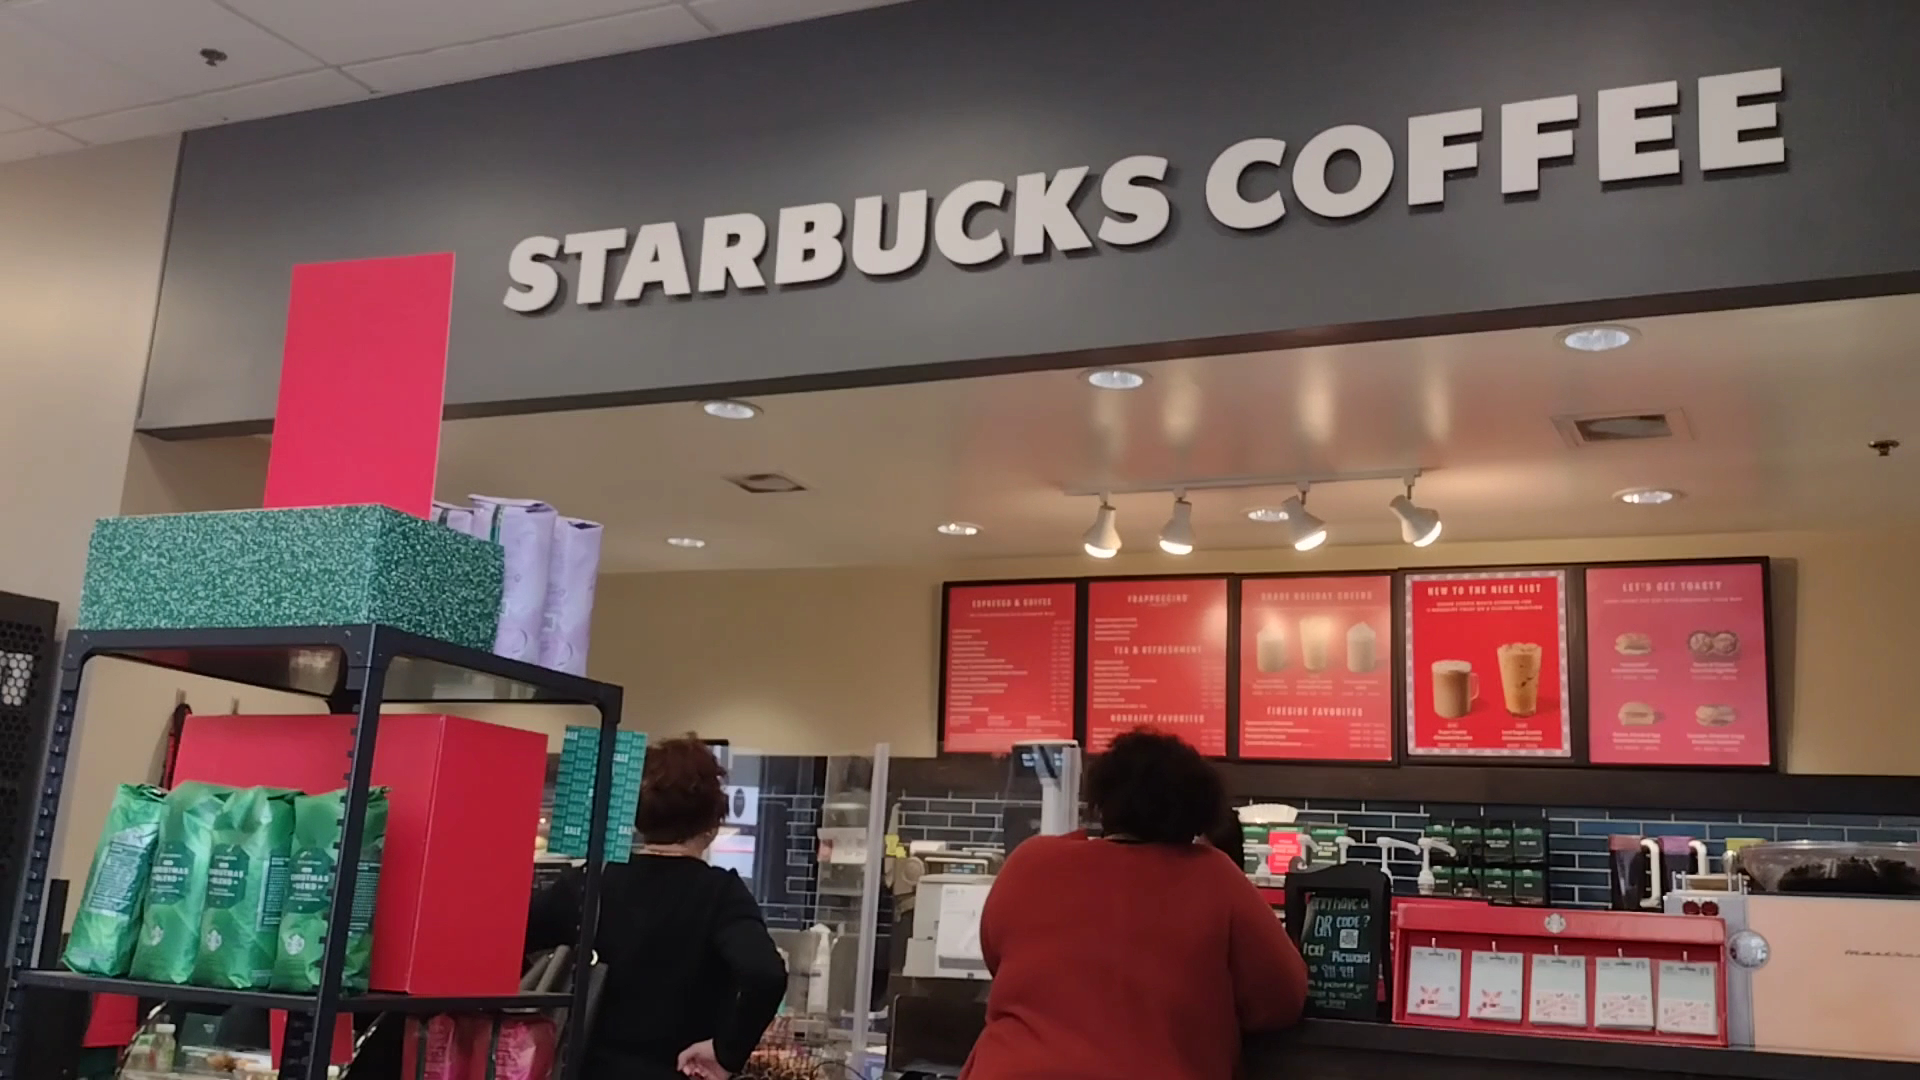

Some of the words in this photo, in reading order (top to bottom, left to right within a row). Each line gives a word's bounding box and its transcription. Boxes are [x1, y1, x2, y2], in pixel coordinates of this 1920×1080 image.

[502, 155, 1171, 313] STARBUCKS
[1205, 67, 1786, 230] COFFEE
[1427, 586, 1449, 597] NEW
[1451, 586, 1464, 596] TO
[1468, 585, 1487, 596] THE
[1491, 584, 1516, 595] NICE
[1518, 583, 1541, 594] LIST
[1622, 582, 1652, 592] LET'S
[1656, 581, 1676, 592] GET
[1314, 915, 1333, 937] QR
